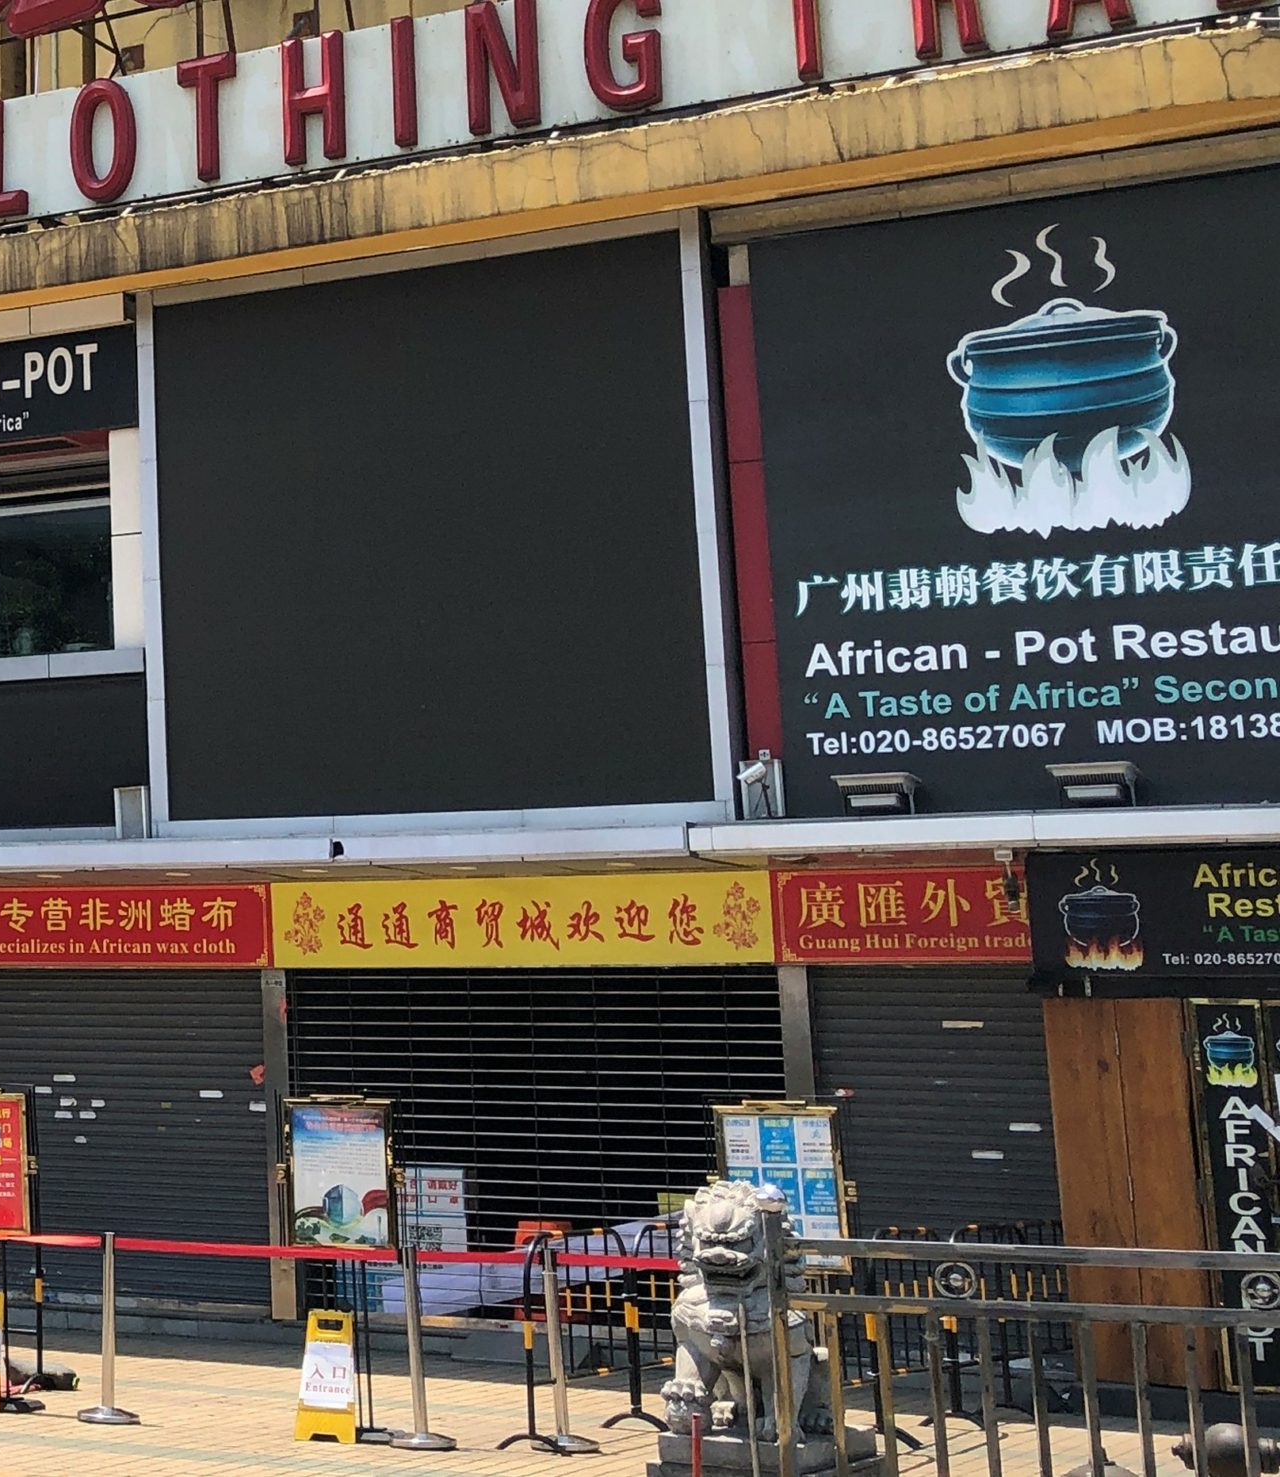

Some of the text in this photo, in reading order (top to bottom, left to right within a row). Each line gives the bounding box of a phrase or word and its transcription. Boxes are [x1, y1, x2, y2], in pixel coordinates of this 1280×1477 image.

[805, 639, 968, 679] African
[1015, 628, 1098, 666] Pot
[1112, 620, 1280, 661] Restau
[858, 688, 952, 718] Taste
[964, 684, 1000, 713] of
[1154, 674, 1277, 704] Secon
[806, 722, 1066, 756] Tel:020-86527067
[1193, 862, 1278, 888] Afric
[337, 892, 705, 951] 通通商贸城欢迎您
[69, 938, 85, 954] in
[88, 937, 151, 955] African
[157, 941, 189, 955] wax
[192, 937, 236, 955] cloth
[799, 933, 860, 953] Guang
[864, 933, 899, 951] Hui
[905, 932, 980, 953] Foreign
[1162, 953, 1190, 966] Tel:
[310, 1363, 346, 1379] 入口
[305, 1382, 350, 1394] Entrance
